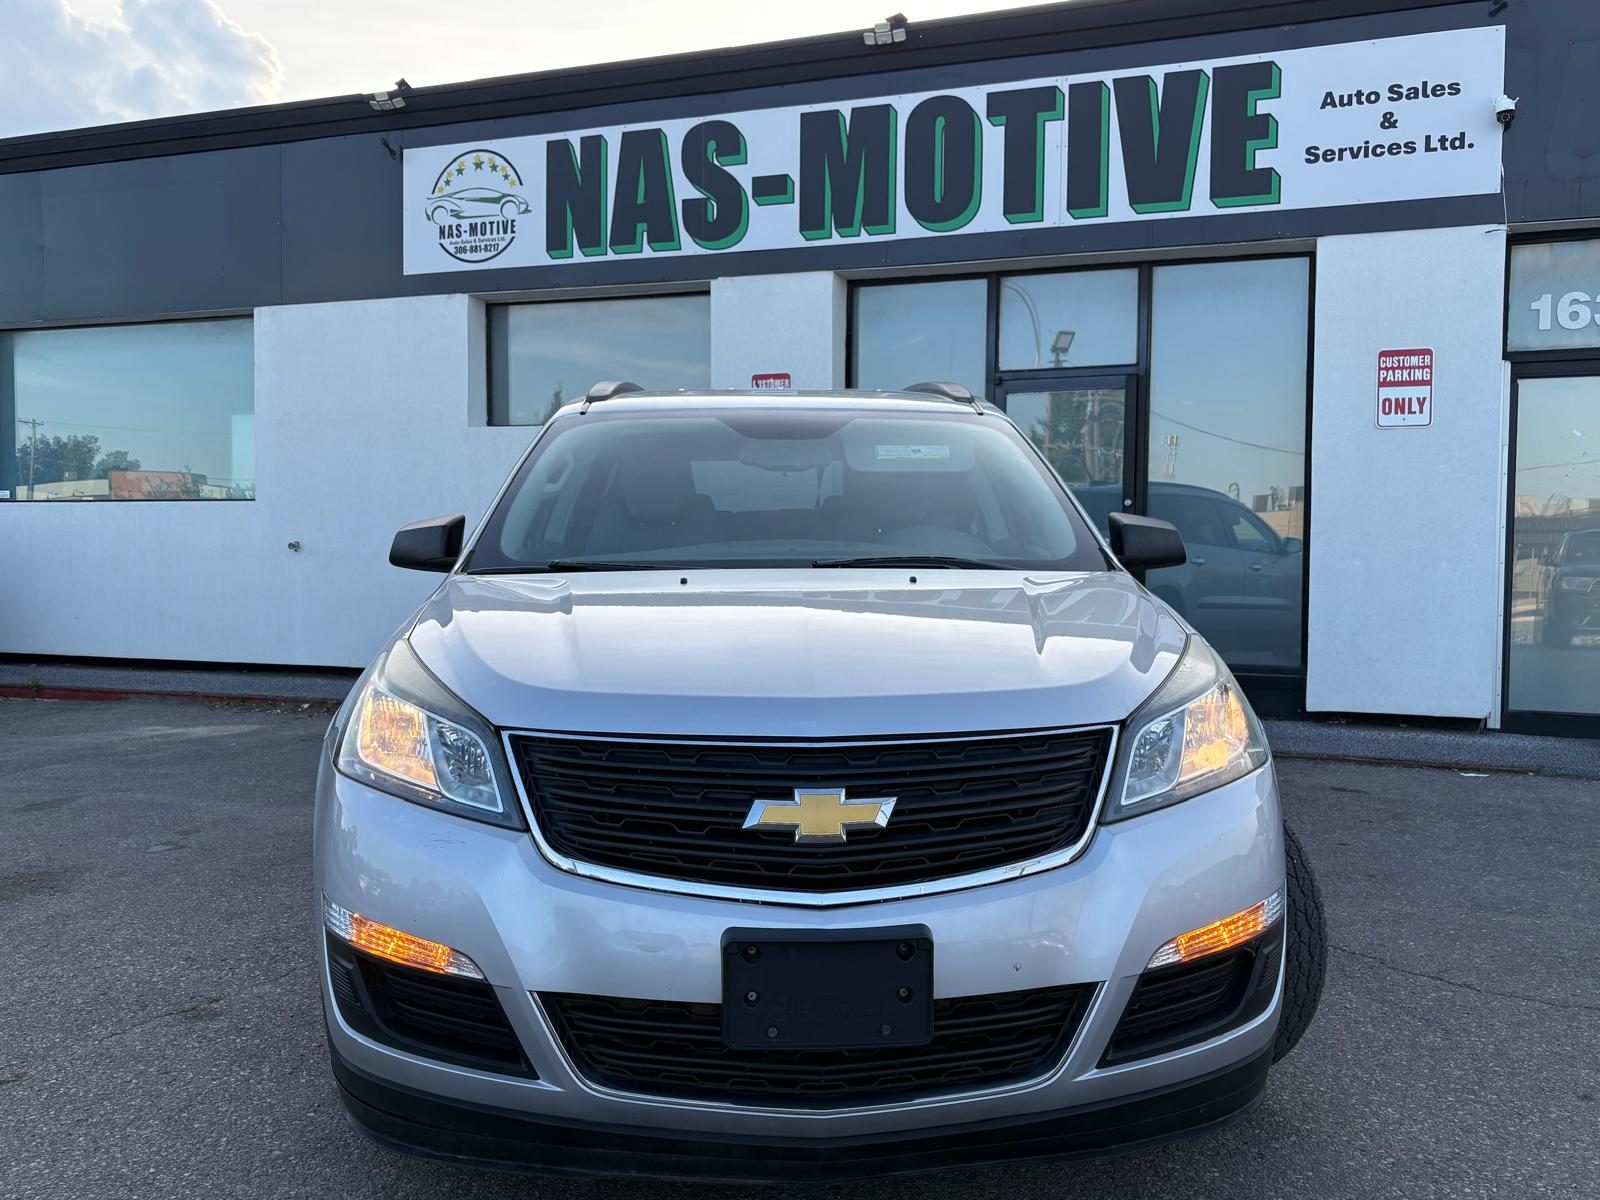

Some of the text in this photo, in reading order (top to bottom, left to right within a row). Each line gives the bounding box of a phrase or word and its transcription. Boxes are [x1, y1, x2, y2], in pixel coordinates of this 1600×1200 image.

[1320, 80, 1461, 110] Auto Sales
[1379, 111, 1399, 130] &
[1304, 131, 1475, 165] Services Ltd.
[546, 60, 1282, 260] NAS-MOTIVE
[439, 219, 516, 240] NAS-MOTIVE
[454, 243, 500, 255] 306-881-8217
[1530, 291, 1600, 331] 16
[1380, 355, 1431, 368] CUSTOMER
[1380, 368, 1431, 382] PARKING
[1381, 396, 1427, 416] ONLY
